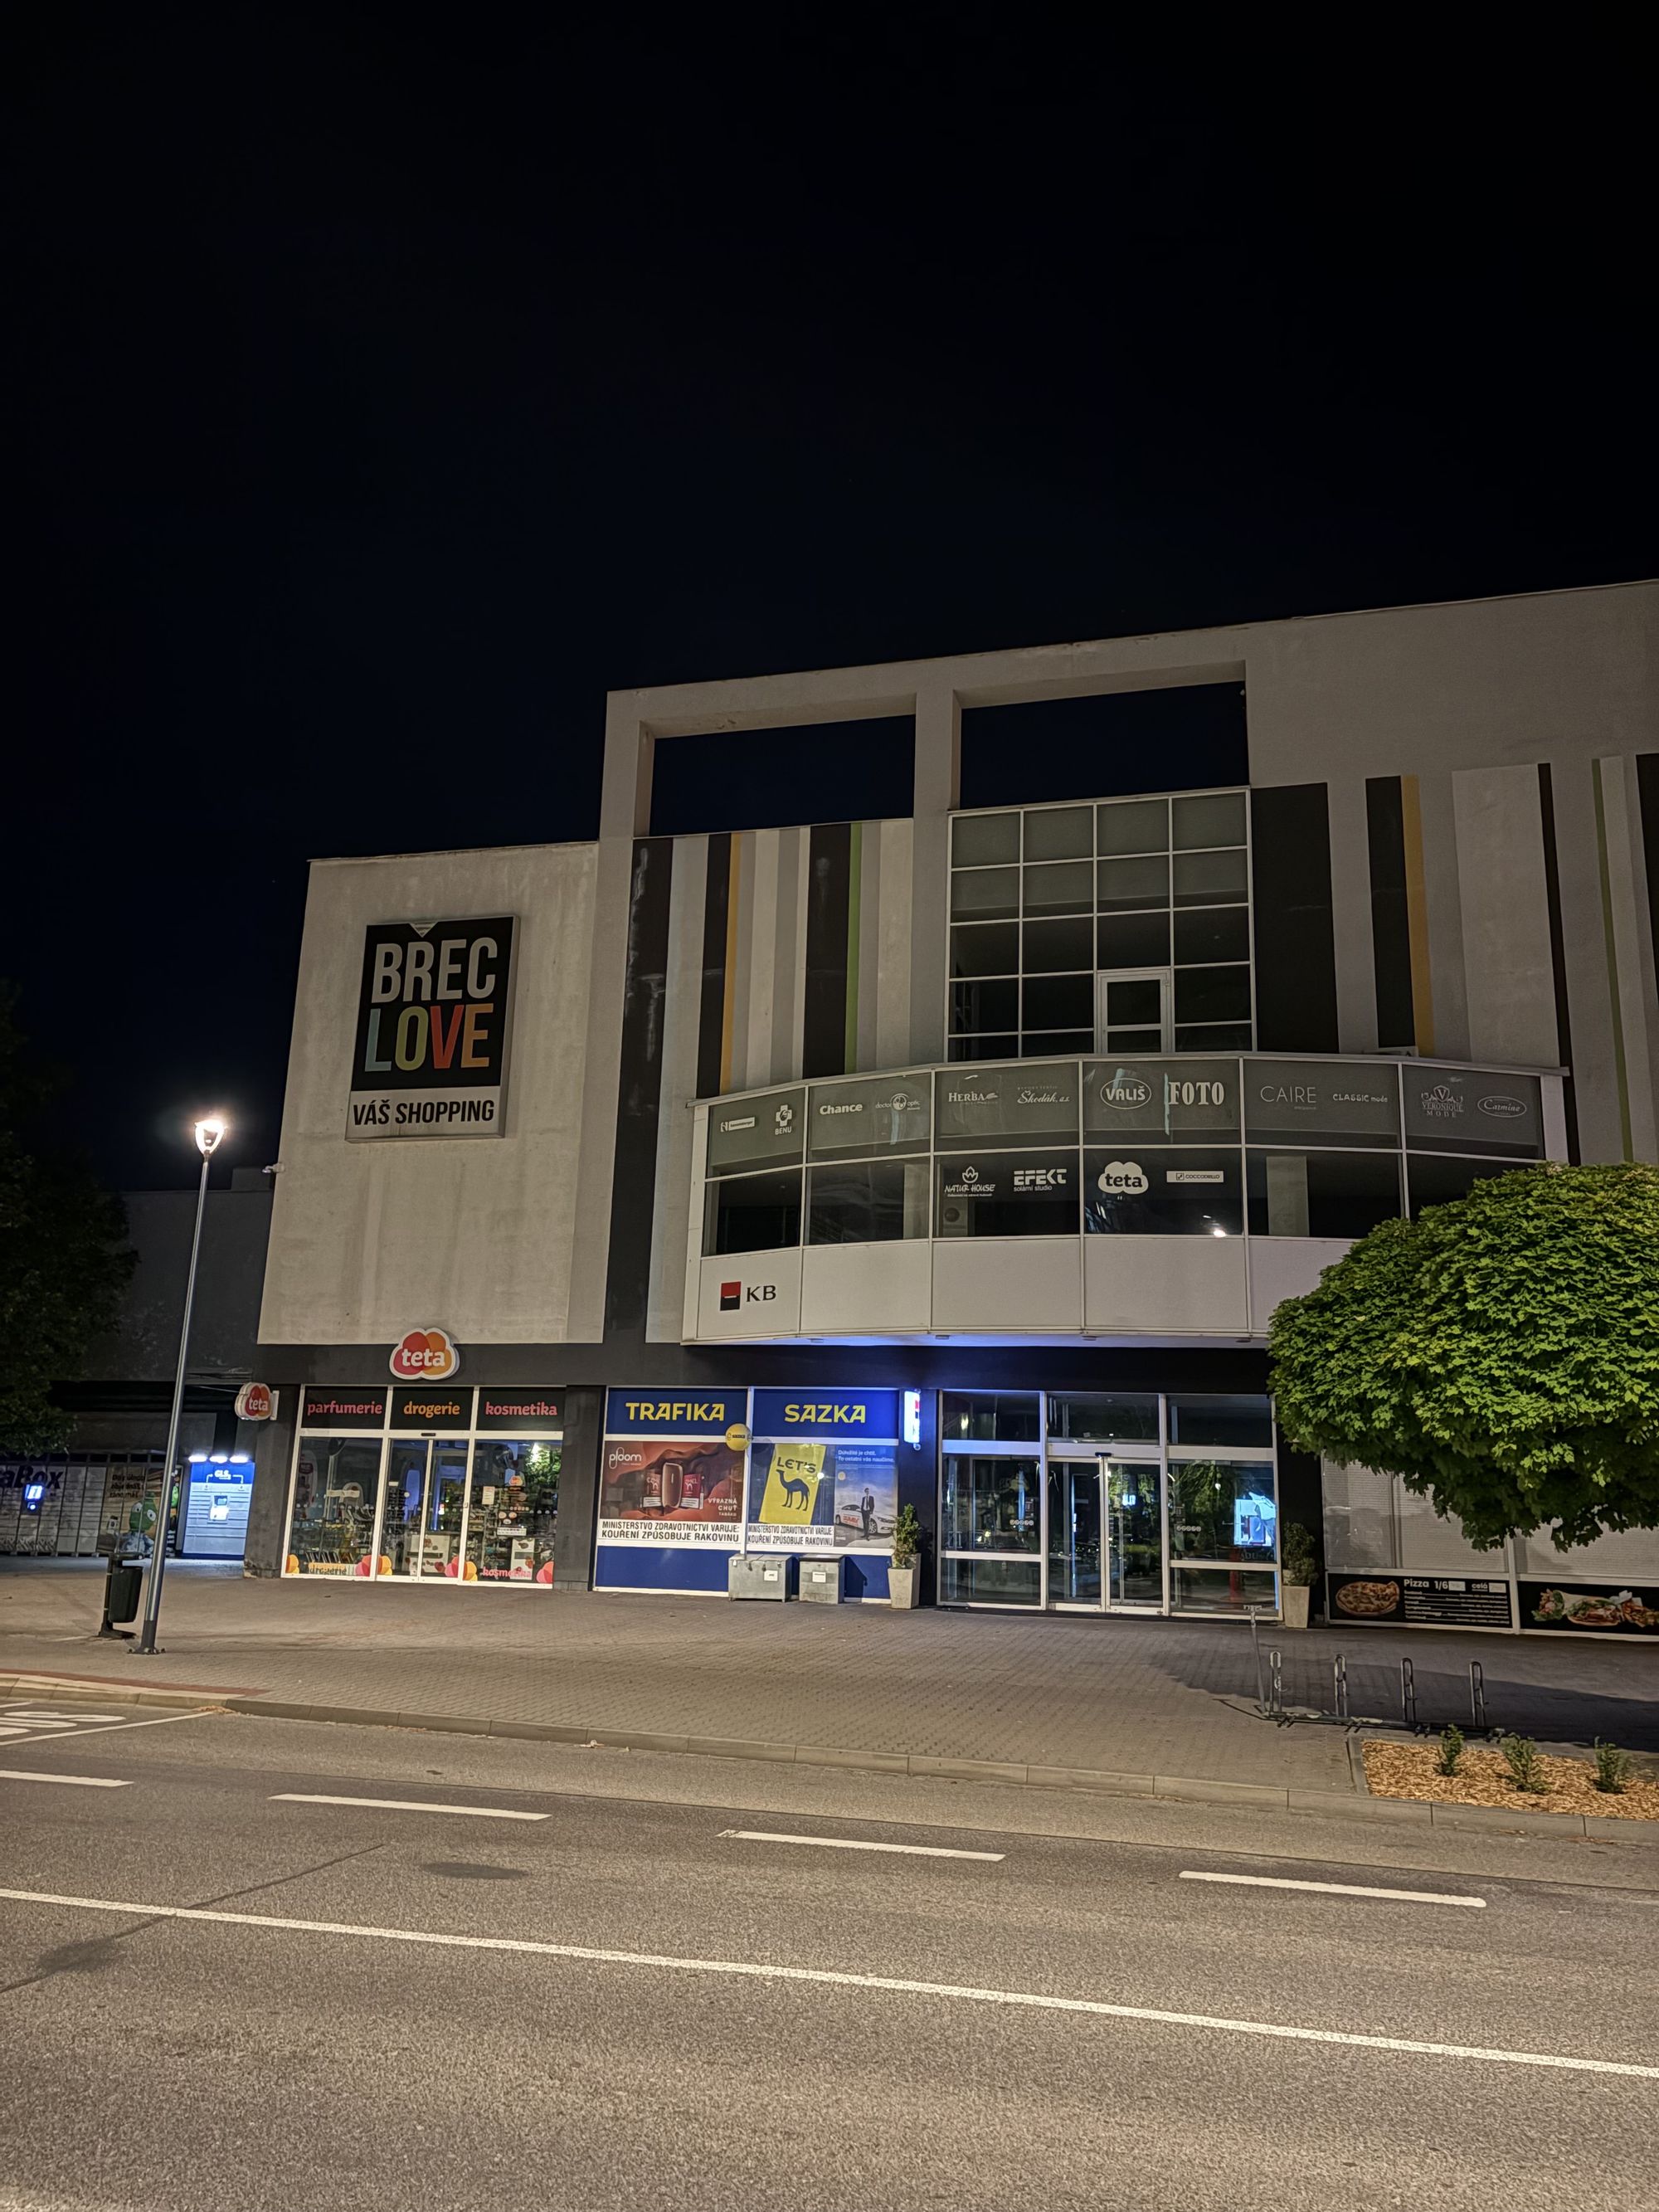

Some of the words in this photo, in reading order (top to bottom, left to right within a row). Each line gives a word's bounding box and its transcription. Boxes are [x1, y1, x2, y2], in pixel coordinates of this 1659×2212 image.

[364, 1002, 494, 1072] LOVE
[1106, 1085, 1146, 1101] VALIŠ
[1169, 1082, 1225, 1105] FOTO
[1260, 1085, 1317, 1104] CAIRE
[1332, 1094, 1369, 1102] CLASSIC
[353, 1099, 391, 1125] VÁŠ
[395, 1099, 494, 1124] SHOPPING
[820, 1104, 864, 1115] Chance
[1014, 1168, 1067, 1186] EFEKT
[1105, 1173, 1143, 1187] teta
[944, 1184, 970, 1193] NATUR
[971, 1184, 995, 1192] HOUSE
[747, 1285, 776, 1302] KB
[401, 1348, 445, 1367] teta
[249, 1396, 268, 1411] teta
[307, 1401, 383, 1416] parfumerie
[404, 1401, 460, 1418] drogerie
[485, 1401, 557, 1416] kosmetika
[625, 1403, 725, 1421] TRAFIKA
[785, 1404, 866, 1424] SAZKA
[609, 1447, 642, 1469] ploom
[777, 1457, 816, 1474] LET'S
[602, 1521, 653, 1530] MINISTERSTVO
[747, 1525, 779, 1533] MINISTERSTVO
[601, 1530, 640, 1538] KOUŘENÍ
[642, 1531, 691, 1541] ZPŮSOBUJE
[695, 1532, 739, 1542] RAKOVINU
[805, 1537, 833, 1546] RAKOVINU
[1404, 1578, 1429, 1588] Pizza
[1434, 1580, 1448, 1591] 1/6
